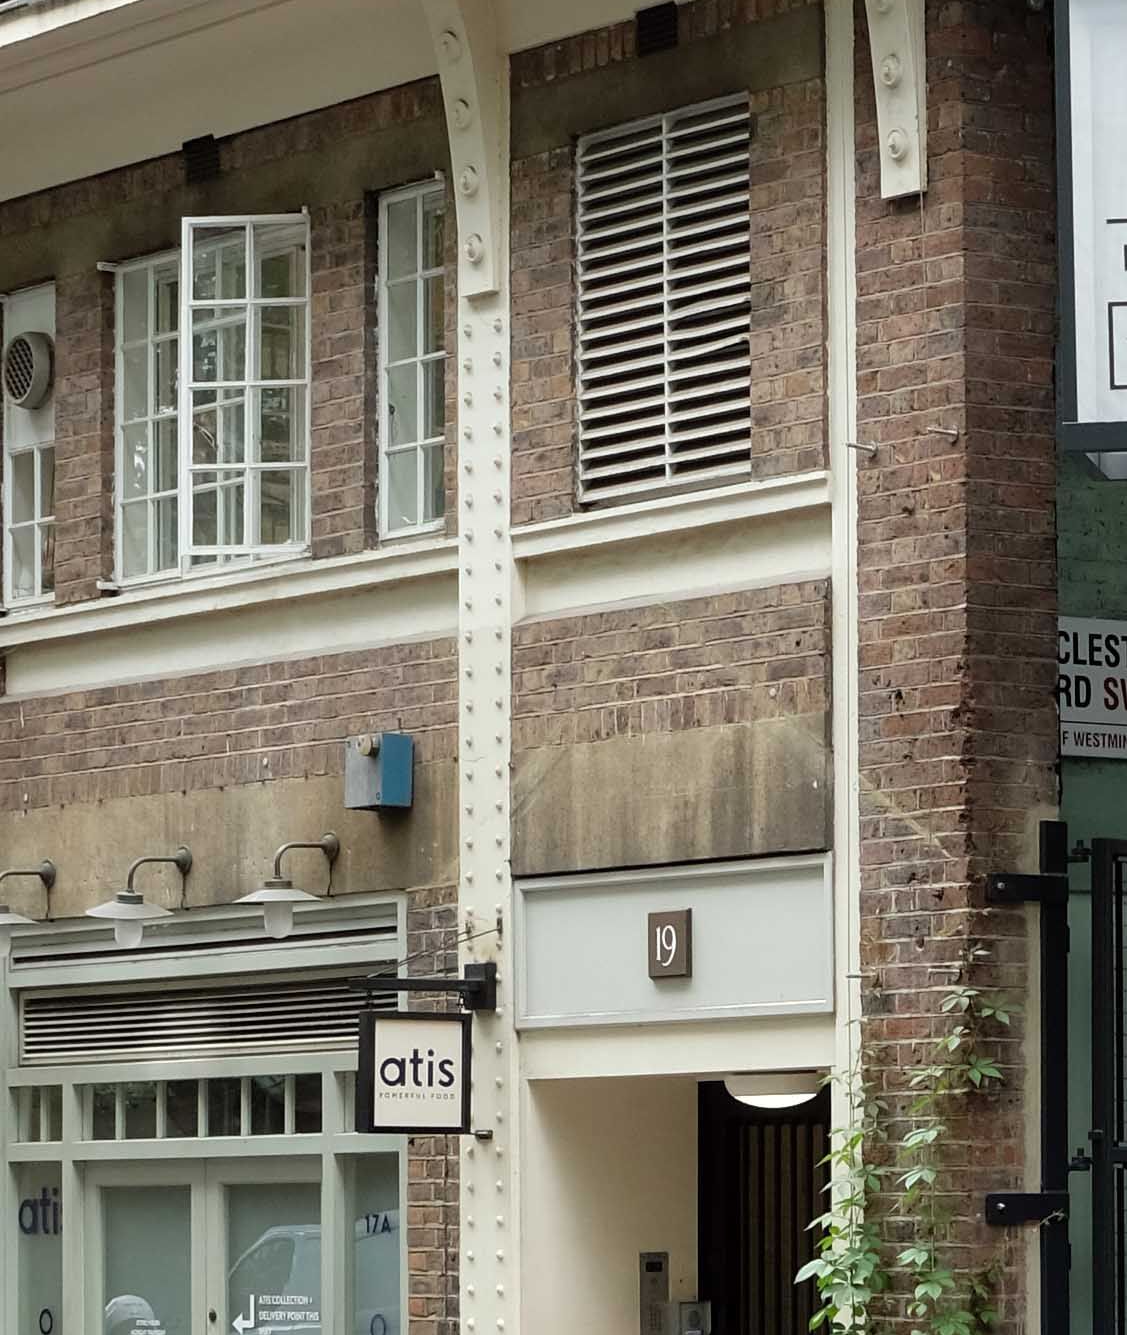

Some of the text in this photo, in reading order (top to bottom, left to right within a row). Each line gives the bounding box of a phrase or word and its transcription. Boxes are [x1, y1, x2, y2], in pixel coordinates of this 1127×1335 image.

[655, 924, 677, 967] 19
[379, 1048, 455, 1088] atis
[430, 1092, 456, 1100] FOOD
[18, 1186, 63, 1236] ati
[364, 1213, 392, 1234] 17A
[258, 1311, 286, 1321] DELIVERY
